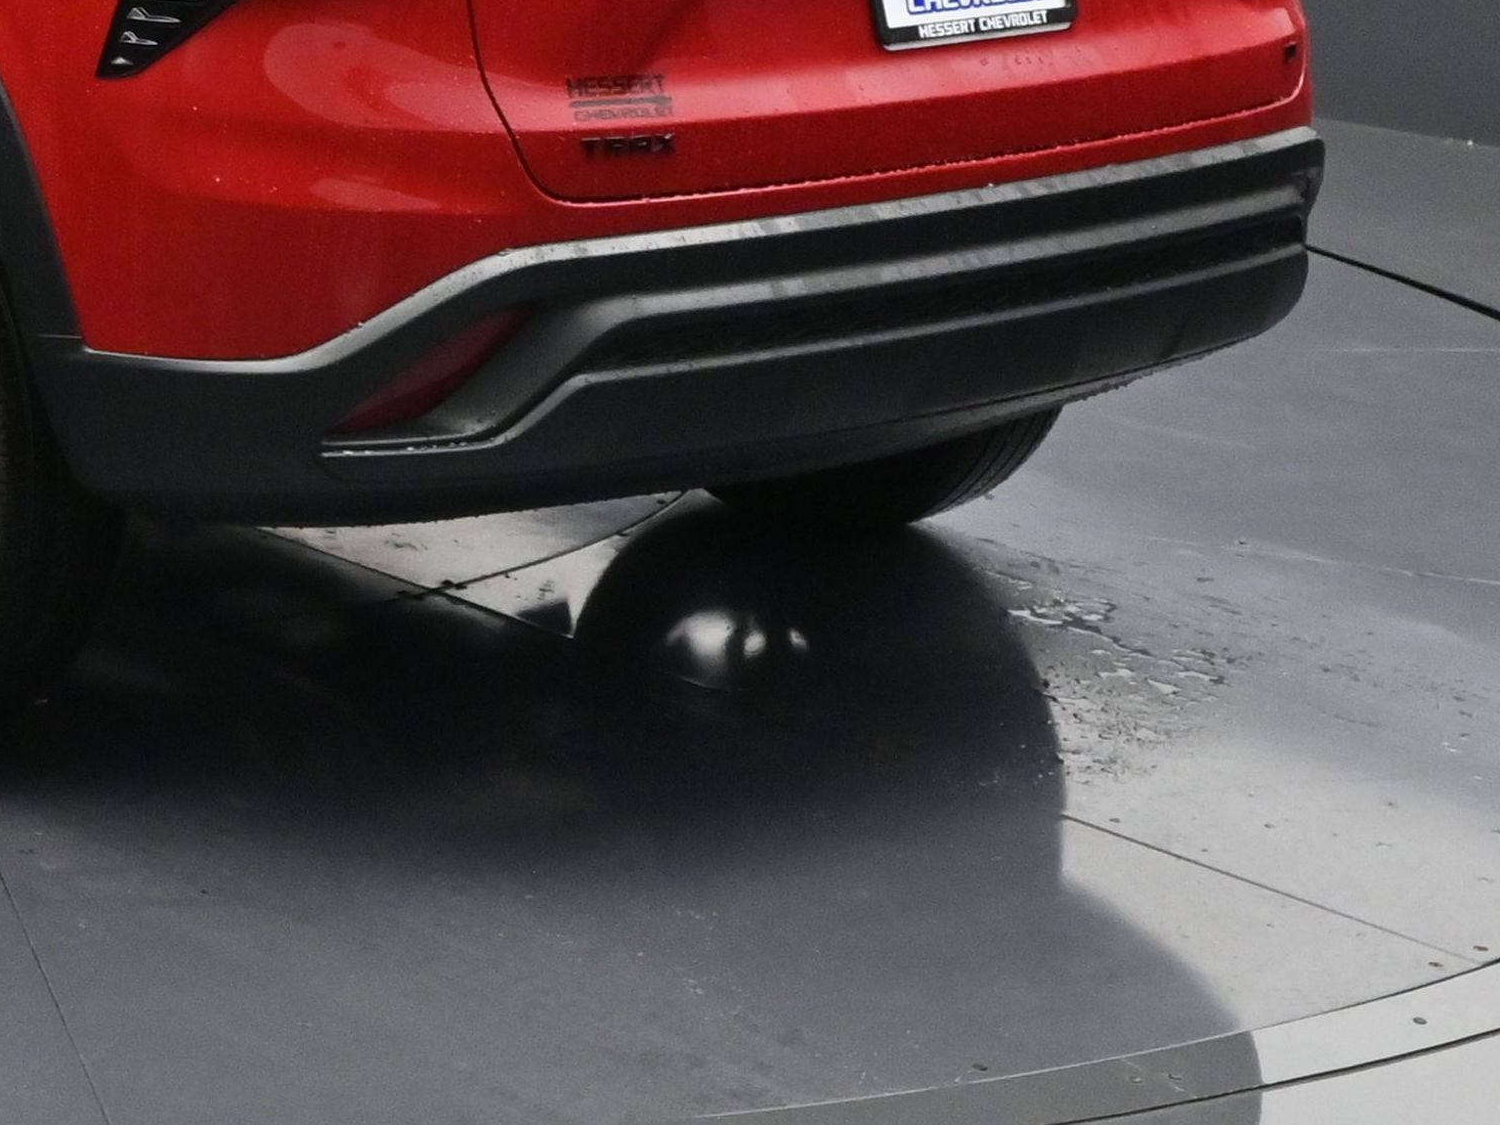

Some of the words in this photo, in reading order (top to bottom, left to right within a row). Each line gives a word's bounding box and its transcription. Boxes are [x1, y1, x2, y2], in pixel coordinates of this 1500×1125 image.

[918, 18, 976, 38] HESSERT
[979, 10, 1048, 31] CHEVROLET
[566, 74, 665, 97] HESSERT
